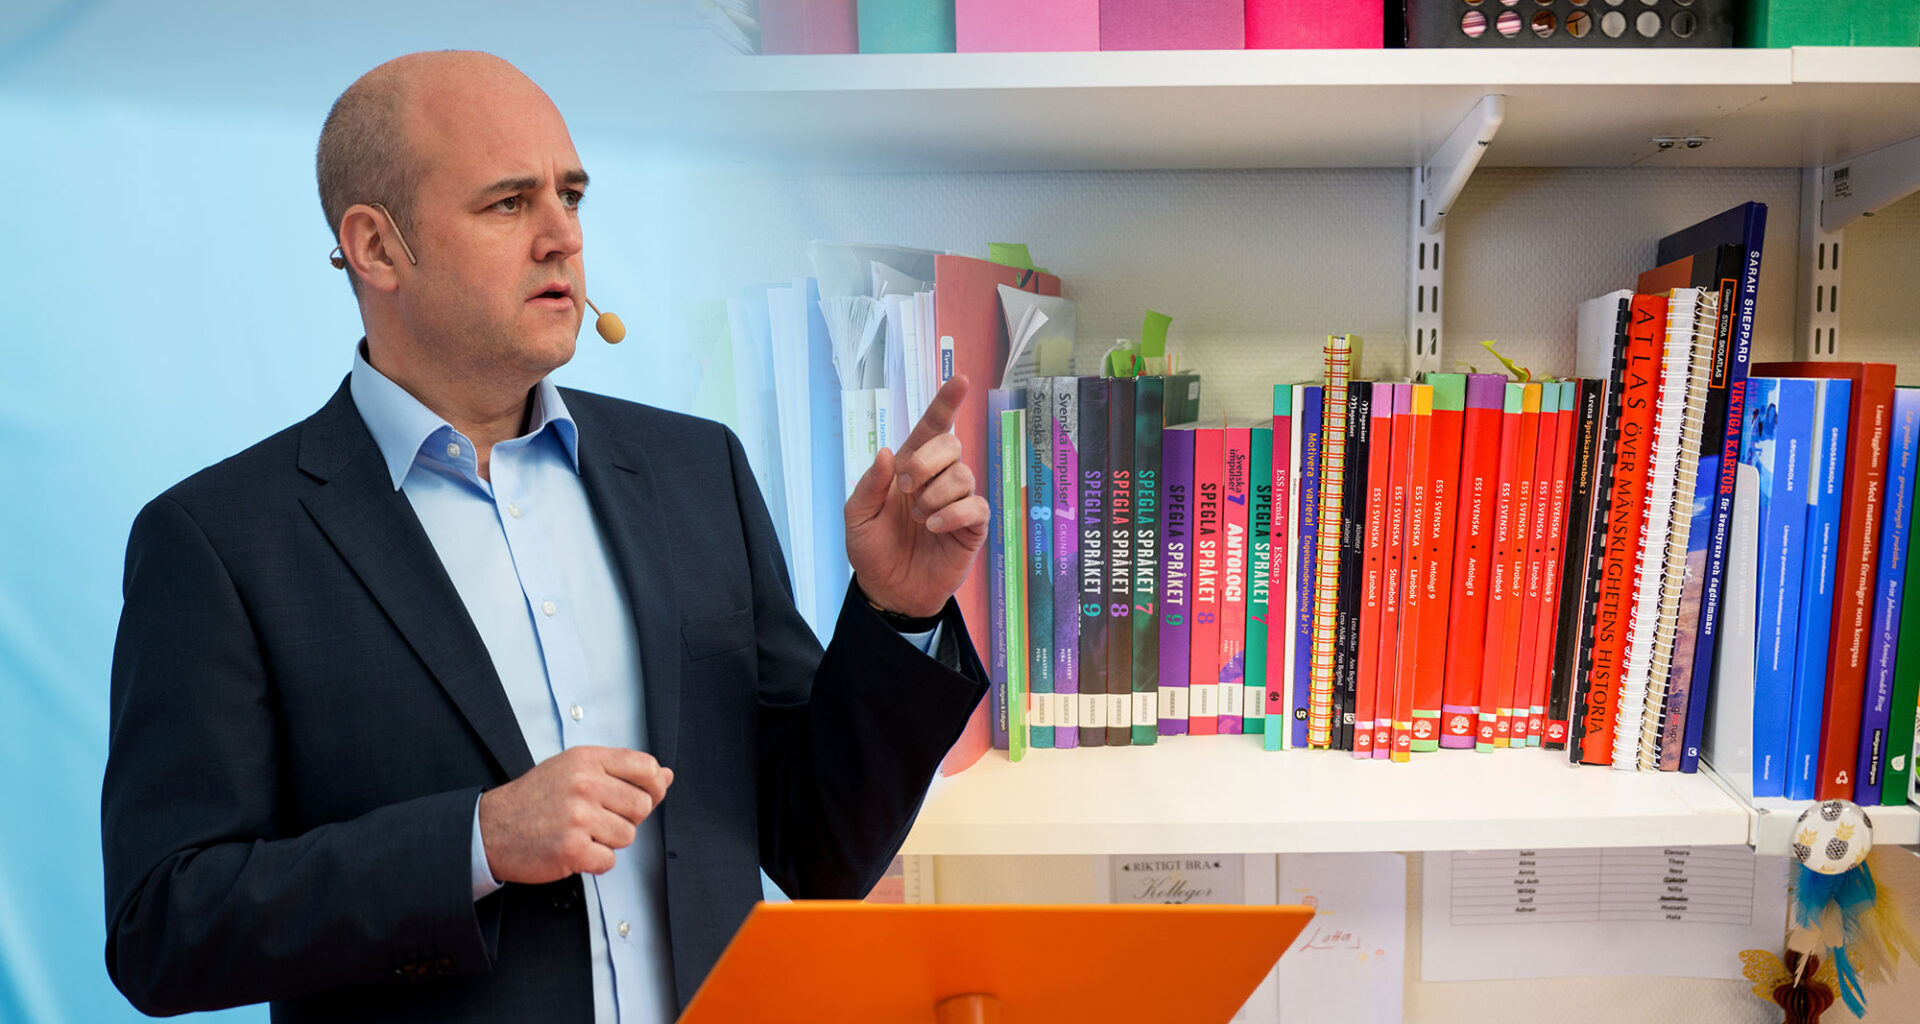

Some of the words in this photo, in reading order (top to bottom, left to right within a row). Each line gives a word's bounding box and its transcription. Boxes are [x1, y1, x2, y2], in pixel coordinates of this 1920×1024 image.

[1746, 251, 1760, 293] SARAH
[1720, 314, 1729, 338] STORA
[1738, 298, 1754, 363] SHEPPARD
[1628, 308, 1655, 410] ATLAS
[1715, 340, 1726, 378] SKOLATLAS
[1033, 392, 1046, 445] Svenska
[1059, 393, 1072, 445] Svenska
[1587, 393, 1597, 420] Arena
[1727, 380, 1746, 436] VIKTIGA
[1875, 405, 1885, 426] Lisen
[1306, 433, 1318, 477] Motivera
[1579, 420, 1594, 488] Språkarbetsbok
[1620, 422, 1643, 472] ÖVER
[1787, 439, 1797, 492] GRUNDSKOLAN
[1870, 428, 1882, 468] Häggblom
[1031, 449, 1047, 506] impulser
[1056, 449, 1072, 506] impulser
[1227, 449, 1239, 492] impulser
[1235, 454, 1246, 493] Svenska
[1276, 469, 1286, 487] ESS
[1719, 439, 1739, 495] KARTOR
[1085, 470, 1101, 525] SPEGLA
[1112, 470, 1129, 525] SPEGLA
[1137, 470, 1155, 525] SPEGLA
[1228, 494, 1245, 506] 7
[1415, 486, 1423, 500] ESS
[1502, 483, 1510, 497] ESS
[1521, 481, 1529, 495] ESS
[1540, 481, 1548, 495] ESS
[1556, 480, 1564, 494] ESS
[1720, 497, 1730, 511] för
[1867, 481, 1878, 502] Med
[1030, 506, 1052, 520] 8
[1055, 507, 1075, 520] 7
[1169, 485, 1185, 537] SPEGLA
[1200, 483, 1217, 536] SPEGLA
[1255, 485, 1271, 538] SPEGLA
[1275, 493, 1284, 526] svenska
[1304, 487, 1314, 527] variera!
[1432, 501, 1442, 539] SVENSKA
[1471, 499, 1481, 536] SVENSKA
[1499, 504, 1509, 542] SVENSKA
[1517, 502, 1527, 540] SVENSKA
[1536, 502, 1546, 540] SVENSKA
[1551, 501, 1561, 538] SVENSKA
[1371, 510, 1380, 548] SVENSKA
[1392, 508, 1401, 546] SVENSKA
[1412, 508, 1422, 547] SVENSKA
[1713, 513, 1729, 558] äventyrare
[1862, 504, 1874, 562] matematiska
[1035, 523, 1043, 576] GRUNDBOK
[1060, 523, 1068, 576] GRUNDBOK
[1084, 529, 1105, 595] SPRÅKET
[1111, 529, 1132, 595] SPRÅKET
[1136, 529, 1158, 595] SPRÅKET
[1226, 523, 1243, 601] ANTOLOGI
[1273, 546, 1283, 577] ESSens
[1600, 479, 1634, 642] MÄNSKLIGHETENS
[1712, 561, 1722, 575] och
[1167, 542, 1187, 605] SPRÅKET
[1198, 540, 1219, 604] SPRÅKET
[1300, 535, 1312, 612] Engelskundervisning
[1368, 570, 1376, 600] Lärobok
[1388, 568, 1397, 605] Studiebok
[1409, 569, 1417, 600] Lärobok
[1427, 561, 1437, 592] Antologi
[1465, 558, 1476, 589] Antologi
[1495, 564, 1504, 594] Lärobok
[1513, 561, 1522, 591] Lärobok
[1531, 561, 1539, 590] Lärobok
[1546, 560, 1555, 595] Studiebok
[1855, 564, 1870, 605] förmågor
[1083, 603, 1101, 617] 9
[1110, 602, 1128, 617] 8
[1135, 602, 1153, 616] 7
[1166, 614, 1183, 626] 9
[1197, 612, 1215, 624] 8
[1251, 613, 1268, 625] 7
[1301, 614, 1309, 622] år
[1704, 578, 1720, 636] dagdrömmare
[1855, 608, 1864, 627] som
[1300, 624, 1309, 635] 1-7
[1850, 628, 1864, 667] kompass
[1884, 632, 1891, 641] &
[1590, 649, 1612, 735] HISTORIA
[1670, 707, 1683, 744] gleerups
[1133, 860, 1183, 871] RIKTIGT
[1185, 860, 1211, 870] BRA
[1133, 877, 1212, 903] Kollegor
